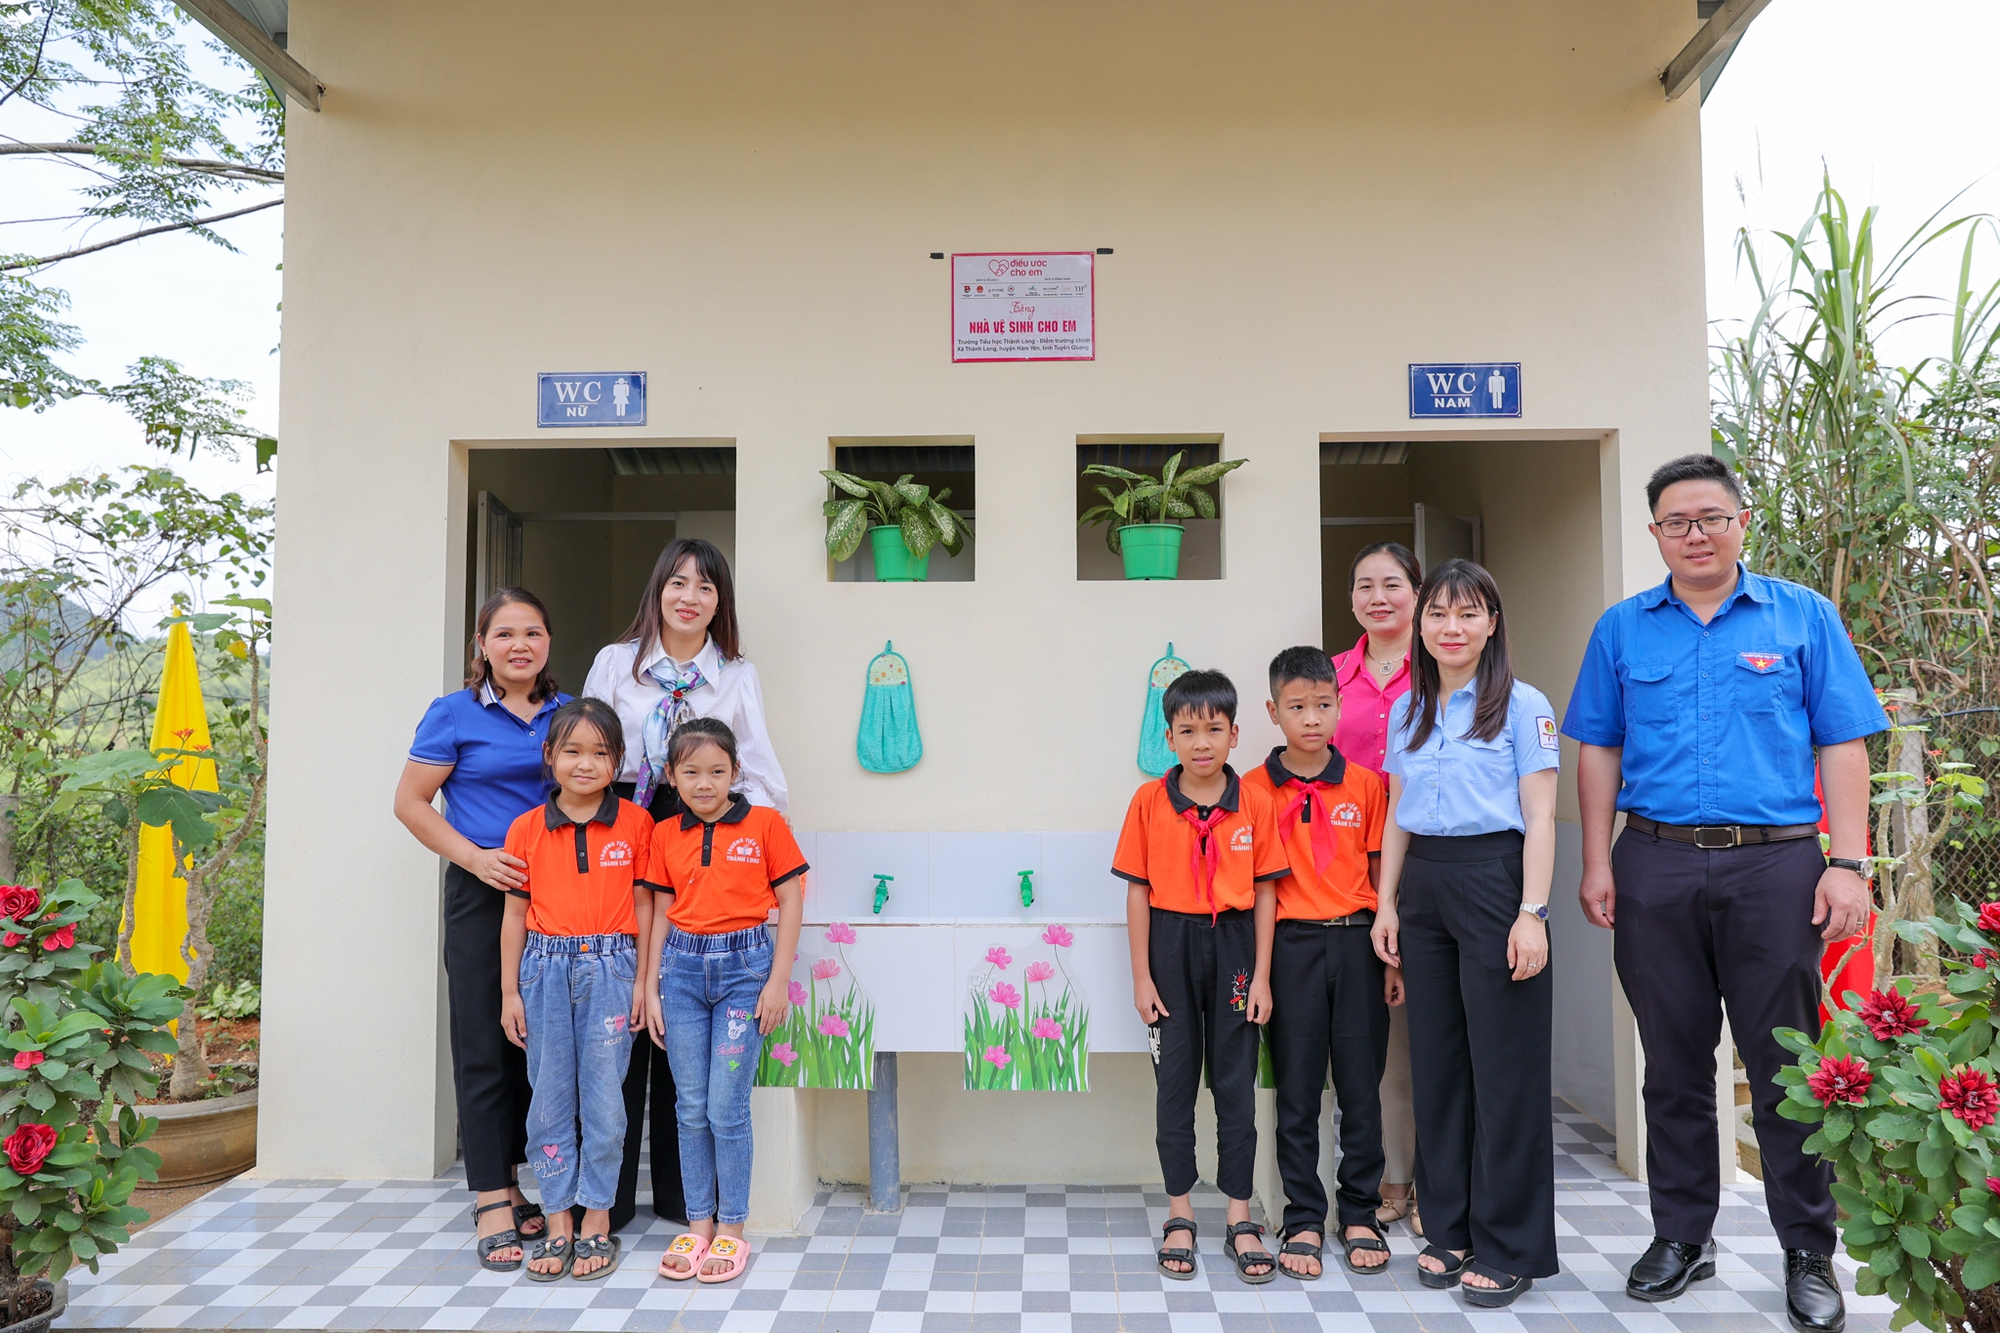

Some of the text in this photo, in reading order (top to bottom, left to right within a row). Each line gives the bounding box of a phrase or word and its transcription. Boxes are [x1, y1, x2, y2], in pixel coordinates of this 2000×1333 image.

[969, 317, 1076, 335] NHÀ VỆ SINH CHO EM
[554, 381, 601, 402] WC
[1426, 372, 1476, 394] WC
[566, 405, 588, 417] NỮ
[1434, 397, 1471, 408] NAM
